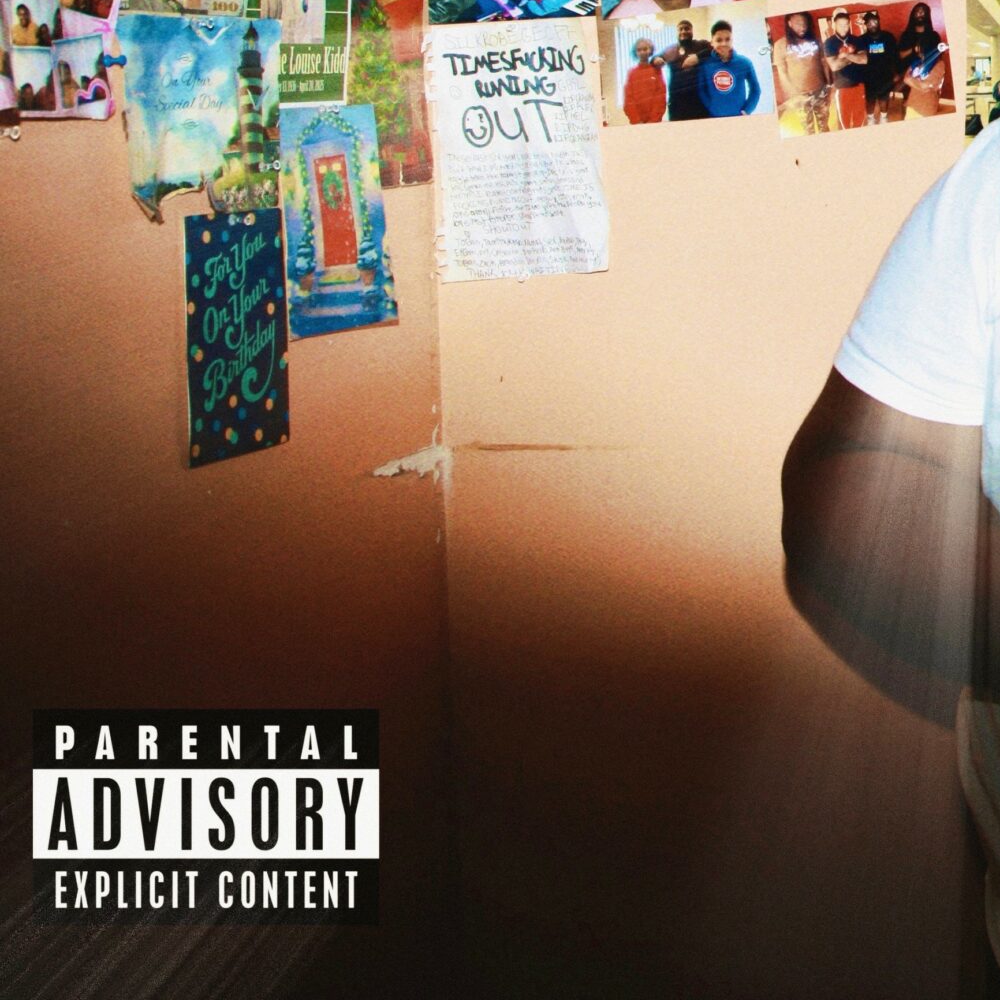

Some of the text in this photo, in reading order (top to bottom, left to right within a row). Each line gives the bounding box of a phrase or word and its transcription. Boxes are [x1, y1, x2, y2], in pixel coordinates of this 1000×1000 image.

[289, 46, 322, 75] Louise
[323, 46, 346, 74] Kidd
[462, 98, 563, 148] OUT
[204, 231, 267, 299] For You
[203, 277, 271, 350] On Your
[203, 318, 276, 412] Birthday
